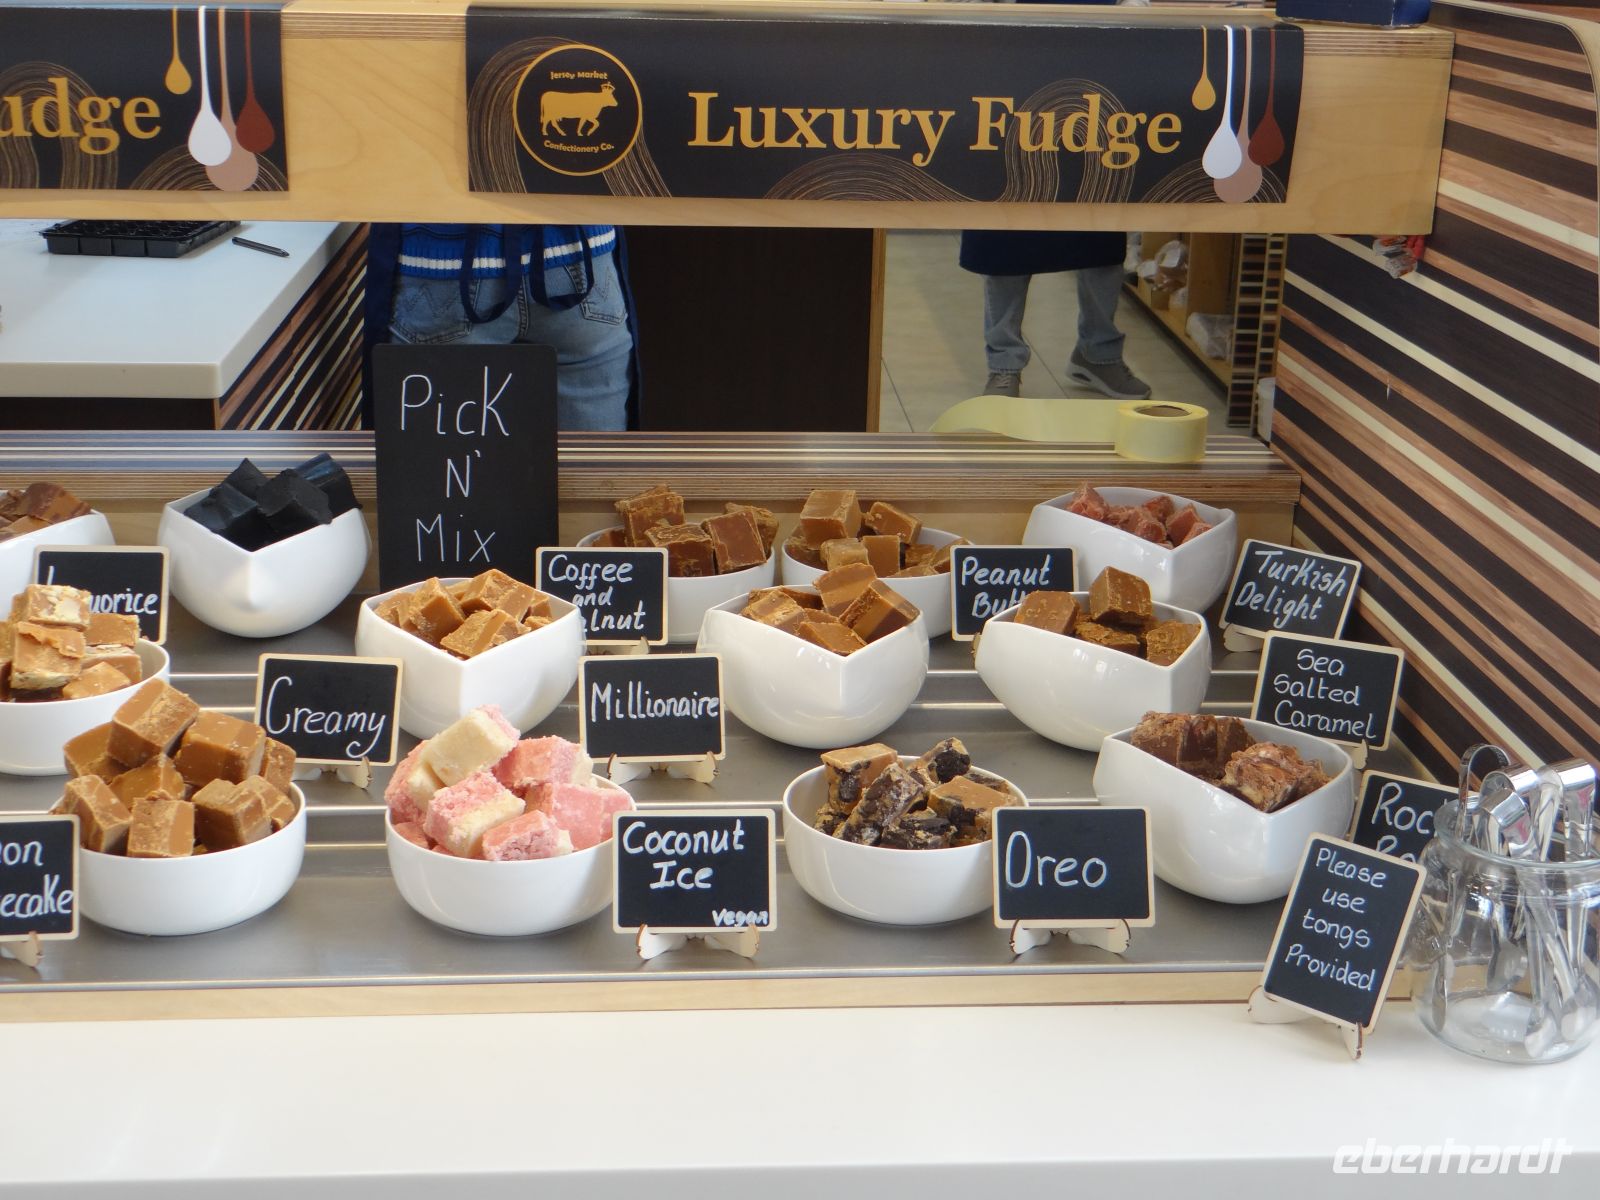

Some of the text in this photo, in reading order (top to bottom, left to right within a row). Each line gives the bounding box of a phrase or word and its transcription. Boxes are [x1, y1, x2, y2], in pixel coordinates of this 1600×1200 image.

[550, 71, 608, 80] Jersey Market
[543, 140, 615, 153] Confectionery Co.
[687, 91, 1182, 170] Luxury Fudge
[416, 513, 496, 563] Mix
[548, 553, 634, 591] Coffee
[961, 553, 1052, 587] Peanut
[571, 585, 614, 607] and
[1234, 581, 1322, 629] Delight
[1296, 648, 1345, 677] Sea
[591, 680, 720, 723] Millionaire
[1273, 673, 1361, 706] Salted
[265, 675, 387, 759] Creamy
[1273, 699, 1377, 739] Caramel
[622, 818, 745, 856] Coconut
[649, 860, 714, 890] Ice
[1005, 830, 1107, 888] Oreo
[1315, 847, 1387, 888] Please
[1322, 887, 1366, 914] use
[1302, 908, 1371, 949] tongs
[1284, 943, 1377, 991] Provided
